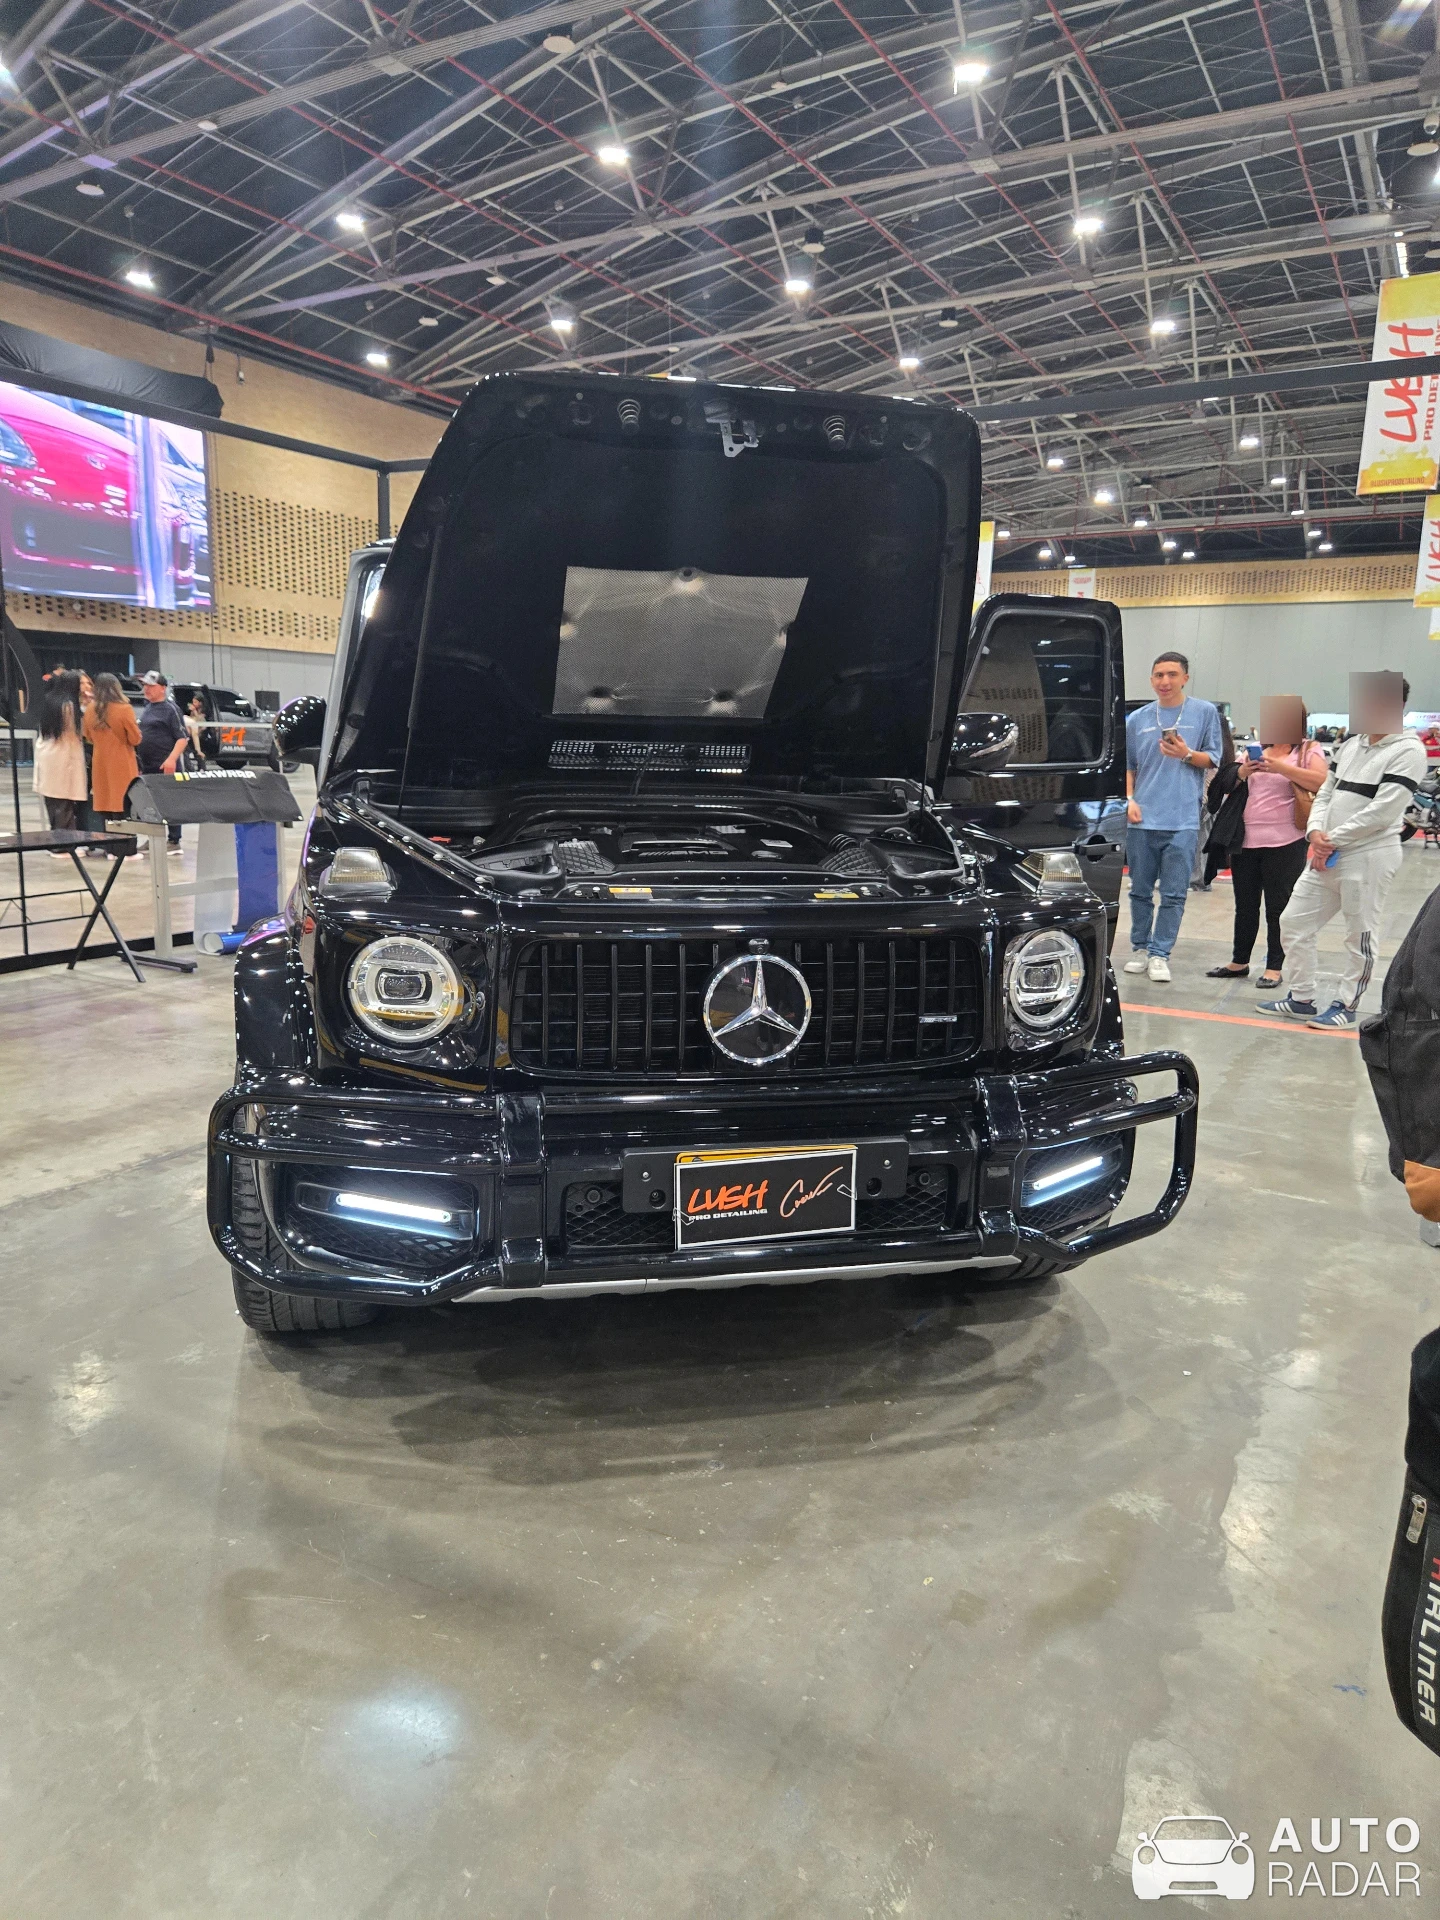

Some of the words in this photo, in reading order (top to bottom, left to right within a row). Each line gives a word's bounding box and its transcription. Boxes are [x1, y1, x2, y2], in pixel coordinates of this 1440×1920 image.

[1423, 407, 1436, 441] PRO
[687, 1179, 769, 1214] LUSH
[689, 1213, 711, 1222] PRO
[712, 1207, 769, 1220] DETAILING
